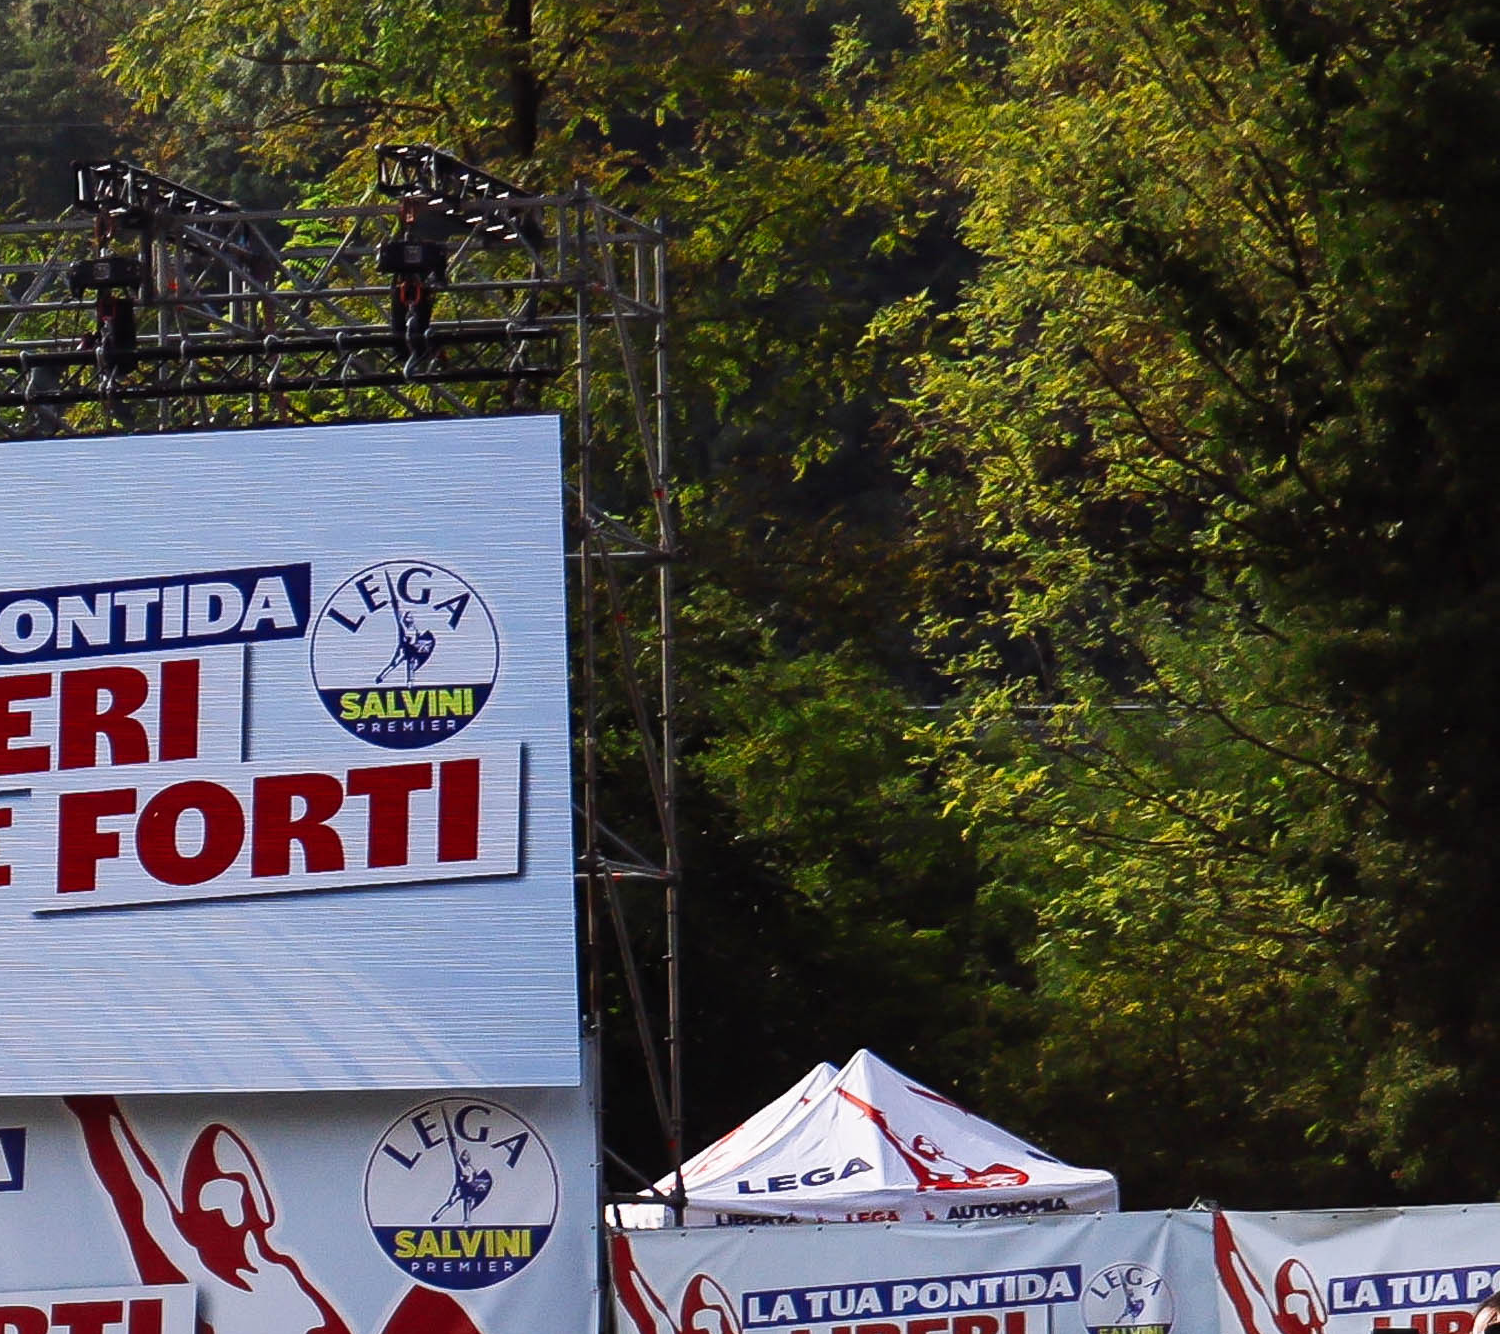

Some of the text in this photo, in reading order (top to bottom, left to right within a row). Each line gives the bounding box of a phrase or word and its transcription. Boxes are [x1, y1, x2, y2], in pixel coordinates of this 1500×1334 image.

[324, 565, 470, 634] LEGA
[339, 685, 475, 720] SALVINI
[355, 718, 458, 734] PREMIER
[56, 756, 481, 895] FORTI
[380, 1101, 529, 1171] LEGA
[737, 1156, 874, 1195] LEGA
[845, 1210, 901, 1223] LEGA
[946, 1197, 1070, 1221] AUTONOMIA
[391, 1225, 532, 1262] SALVINI
[410, 1259, 517, 1274] PREMIER
[1090, 1266, 1163, 1300] LEGA
[747, 1272, 1075, 1324] LA TUA PONTIDA
[1332, 1279, 1381, 1310] LA
[1387, 1273, 1460, 1305] TUA
